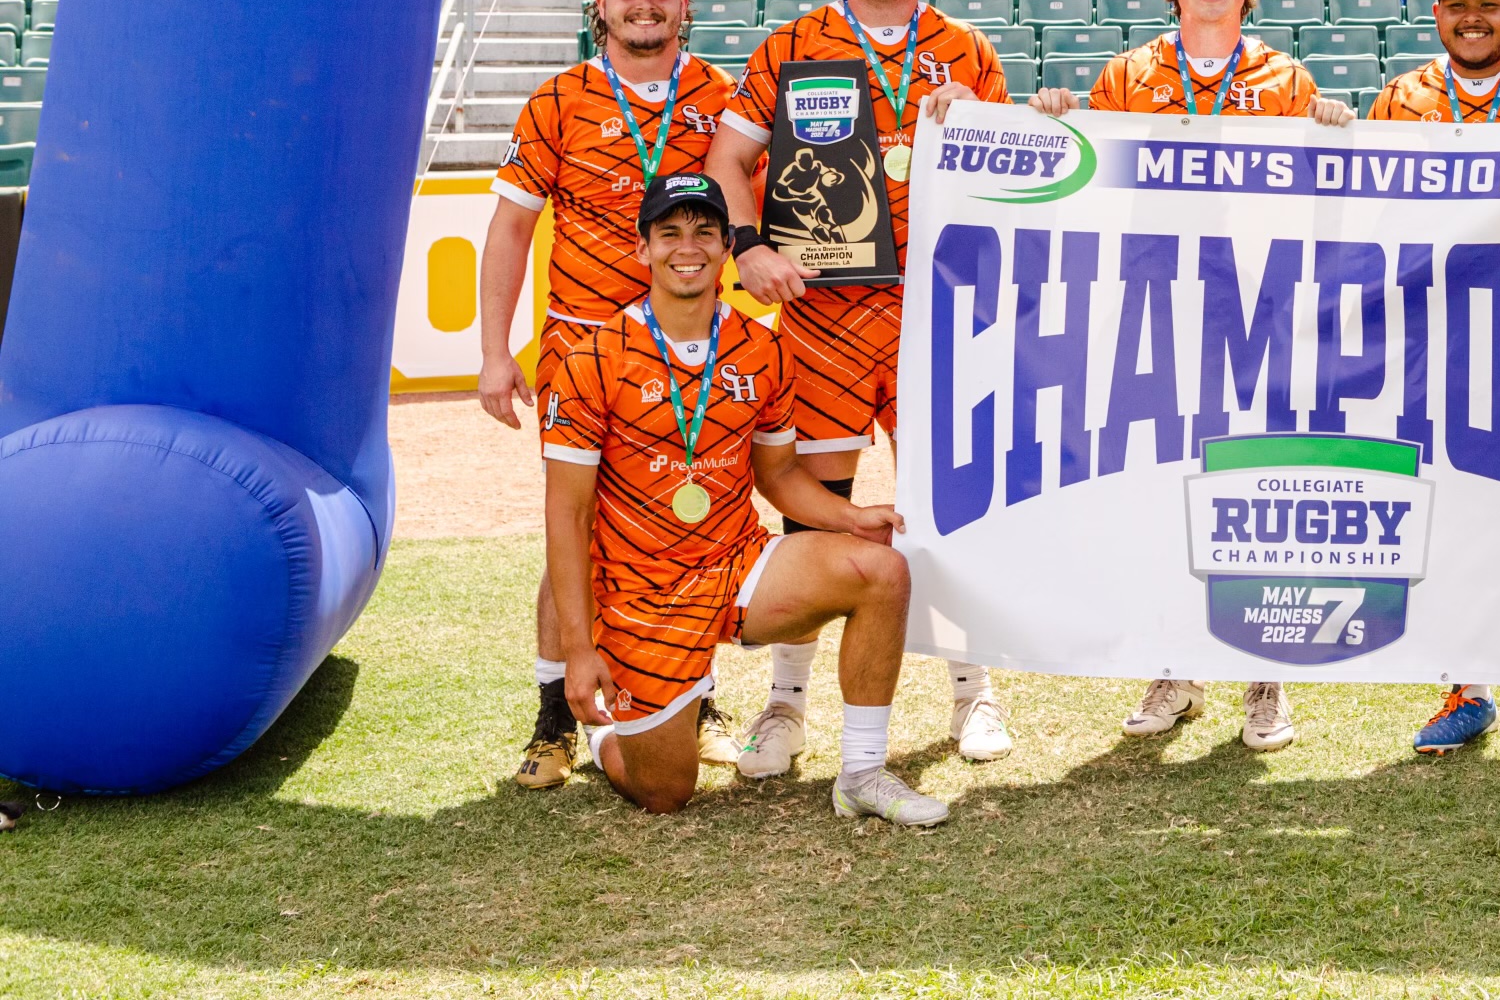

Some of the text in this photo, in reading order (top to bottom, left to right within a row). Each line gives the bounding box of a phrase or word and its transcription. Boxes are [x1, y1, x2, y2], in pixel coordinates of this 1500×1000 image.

[918, 51, 953, 85] SH
[795, 96, 851, 110] RUGBY
[1229, 80, 1265, 111] SH
[943, 127, 1069, 149] NATIONAL COLLEGIATE
[937, 143, 1065, 178] RUGBY
[801, 252, 853, 261] CHAMPION
[720, 364, 759, 402] SH
[703, 454, 739, 469] Mutual
[1257, 478, 1364, 495] COLLEGIATE
[1212, 496, 1411, 546] RUGBY
[1212, 549, 1401, 565] CHAMPIONSHIP
[1262, 586, 1306, 606] MAY
[1244, 608, 1323, 625] MADNESS
[1261, 626, 1306, 643] 2022
